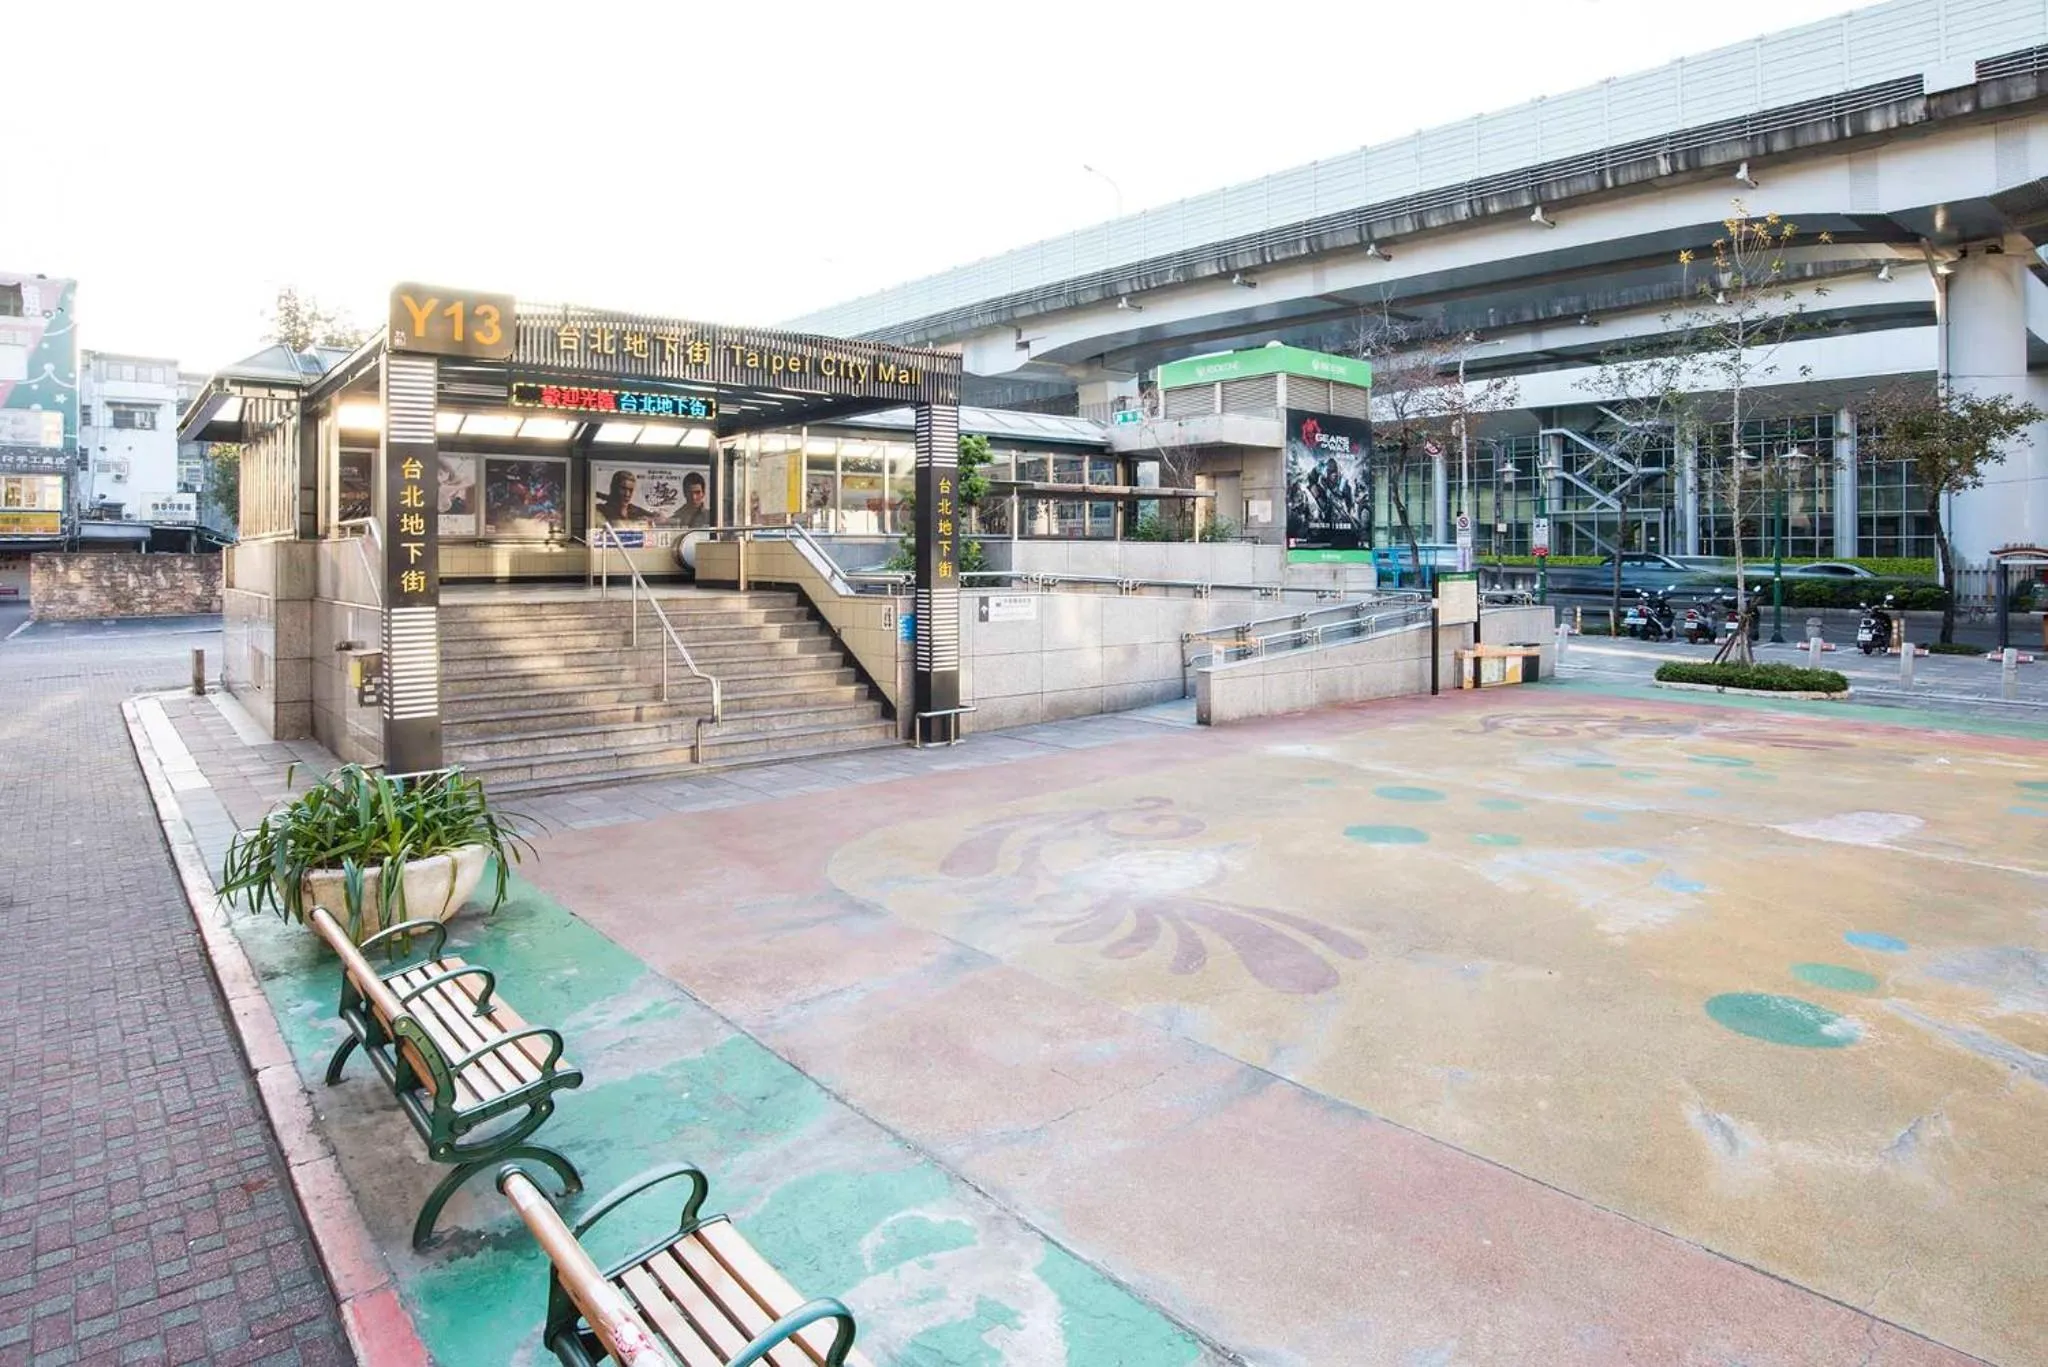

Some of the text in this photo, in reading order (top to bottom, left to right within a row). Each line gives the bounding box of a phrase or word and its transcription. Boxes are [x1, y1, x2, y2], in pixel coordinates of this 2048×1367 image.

[402, 295, 502, 346] Y13
[557, 326, 922, 386] 台北地下街 Taipei City Mall
[619, 392, 707, 417] 台北地下街
[401, 457, 426, 593] 台北地下街
[938, 477, 953, 578] 台北地下街
